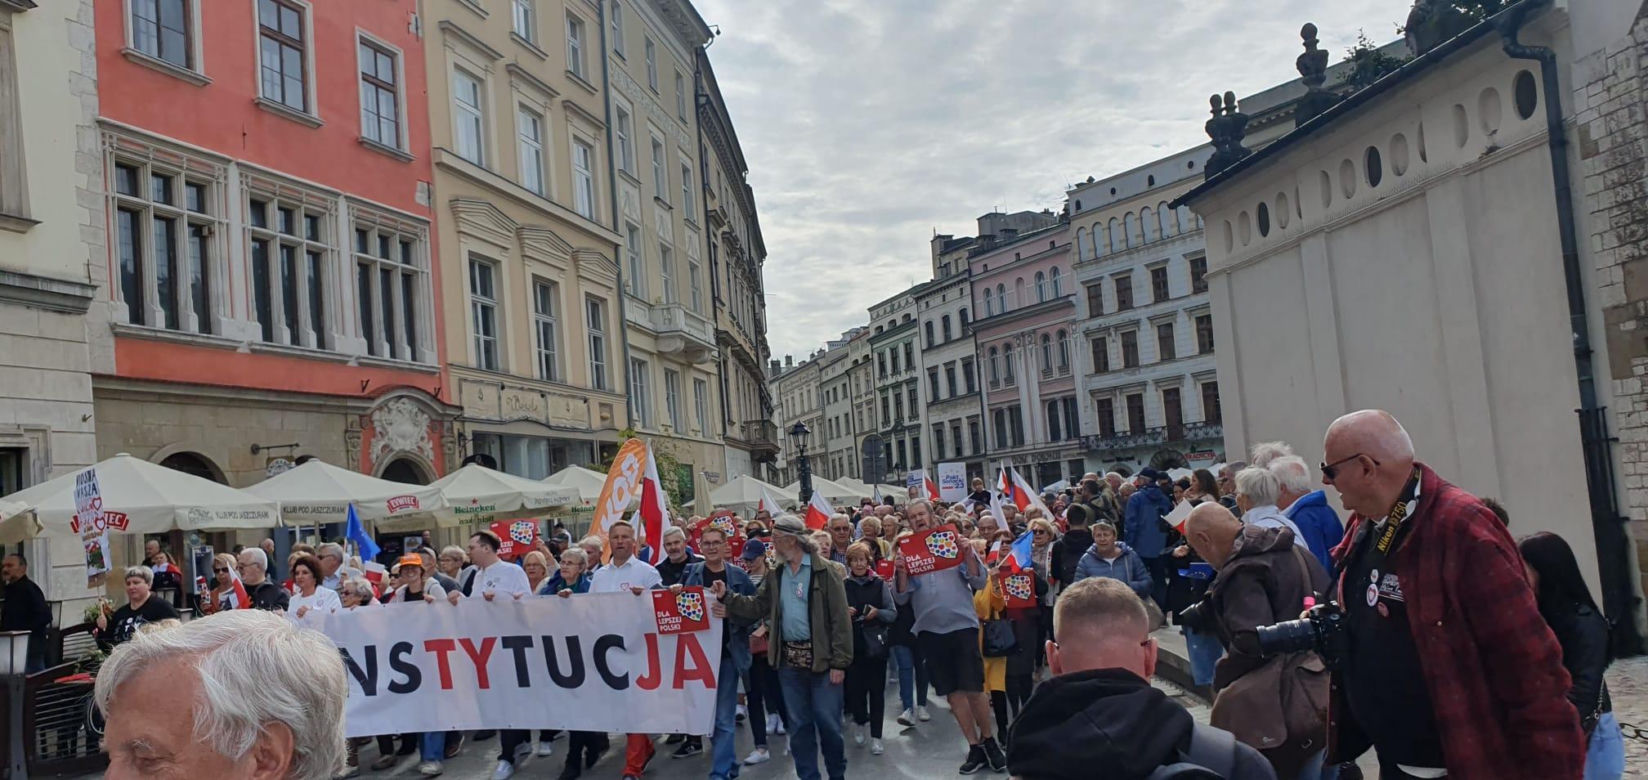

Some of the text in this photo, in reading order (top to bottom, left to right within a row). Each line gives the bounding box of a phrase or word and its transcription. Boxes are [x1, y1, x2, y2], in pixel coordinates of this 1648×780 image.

[455, 505, 496, 514] Heineken
[1377, 526, 1395, 551] Nikon
[906, 554, 920, 562] DLA
[910, 564, 934, 574] POLSKI
[660, 623, 681, 632] POLSKI
[337, 633, 717, 696] NSTYTUCJA
